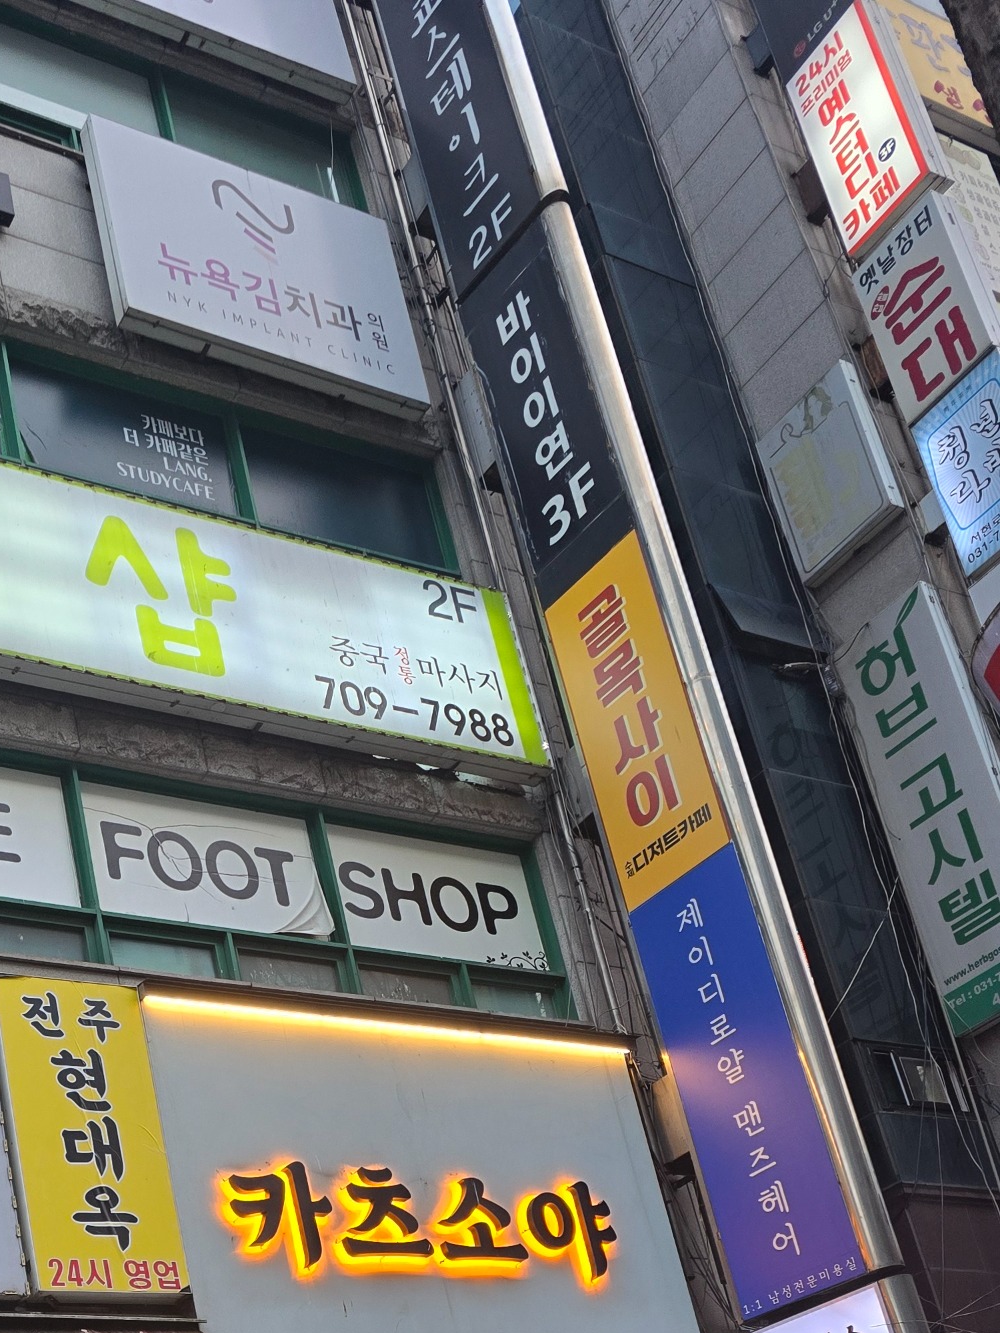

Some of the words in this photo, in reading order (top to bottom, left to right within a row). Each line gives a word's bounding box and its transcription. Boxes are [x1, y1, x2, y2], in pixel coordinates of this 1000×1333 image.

[795, 31, 844, 97] 24시
[801, 49, 853, 118] 프리미엄
[879, 139, 896, 161] 3F
[468, 192, 512, 270] 2F
[843, 166, 901, 240] 카페
[859, 205, 934, 295] 옛날장터
[158, 242, 362, 342] 뉴욕김치과
[167, 290, 207, 313] NYK
[222, 308, 313, 348] IMPLANT
[328, 343, 396, 375] CLINIC
[883, 256, 977, 402] 순대
[123, 427, 140, 447] 더
[144, 433, 209, 466] 카페같은
[141, 414, 204, 447] 카페보다
[116, 461, 216, 501] STUDYCAFE
[163, 456, 213, 483] LANG.
[540, 462, 596, 547] 3F
[422, 579, 478, 624] 2F
[329, 635, 390, 676] 중국
[393, 646, 417, 685] 정통
[416, 656, 504, 701] 마사지
[314, 674, 515, 747] 709-7988
[577, 583, 683, 828] 골목사이
[855, 586, 1000, 947] 허브고시텔
[632, 803, 713, 872] 디저트카페
[100, 820, 295, 907] FOOT
[338, 860, 519, 934] SHOP
[20, 991, 121, 1043] 전주
[676, 897, 746, 1084] 제이디로얄
[733, 1100, 802, 1257] 맨즈헤어
[49, 1048, 140, 1252] 현대옥
[220, 1158, 620, 1286] 카츠소야
[46, 1257, 112, 1290] 24시
[123, 1260, 180, 1291] 영업
[743, 1300, 763, 1316] 1:1
[768, 1256, 858, 1306] 남성전문미용실
